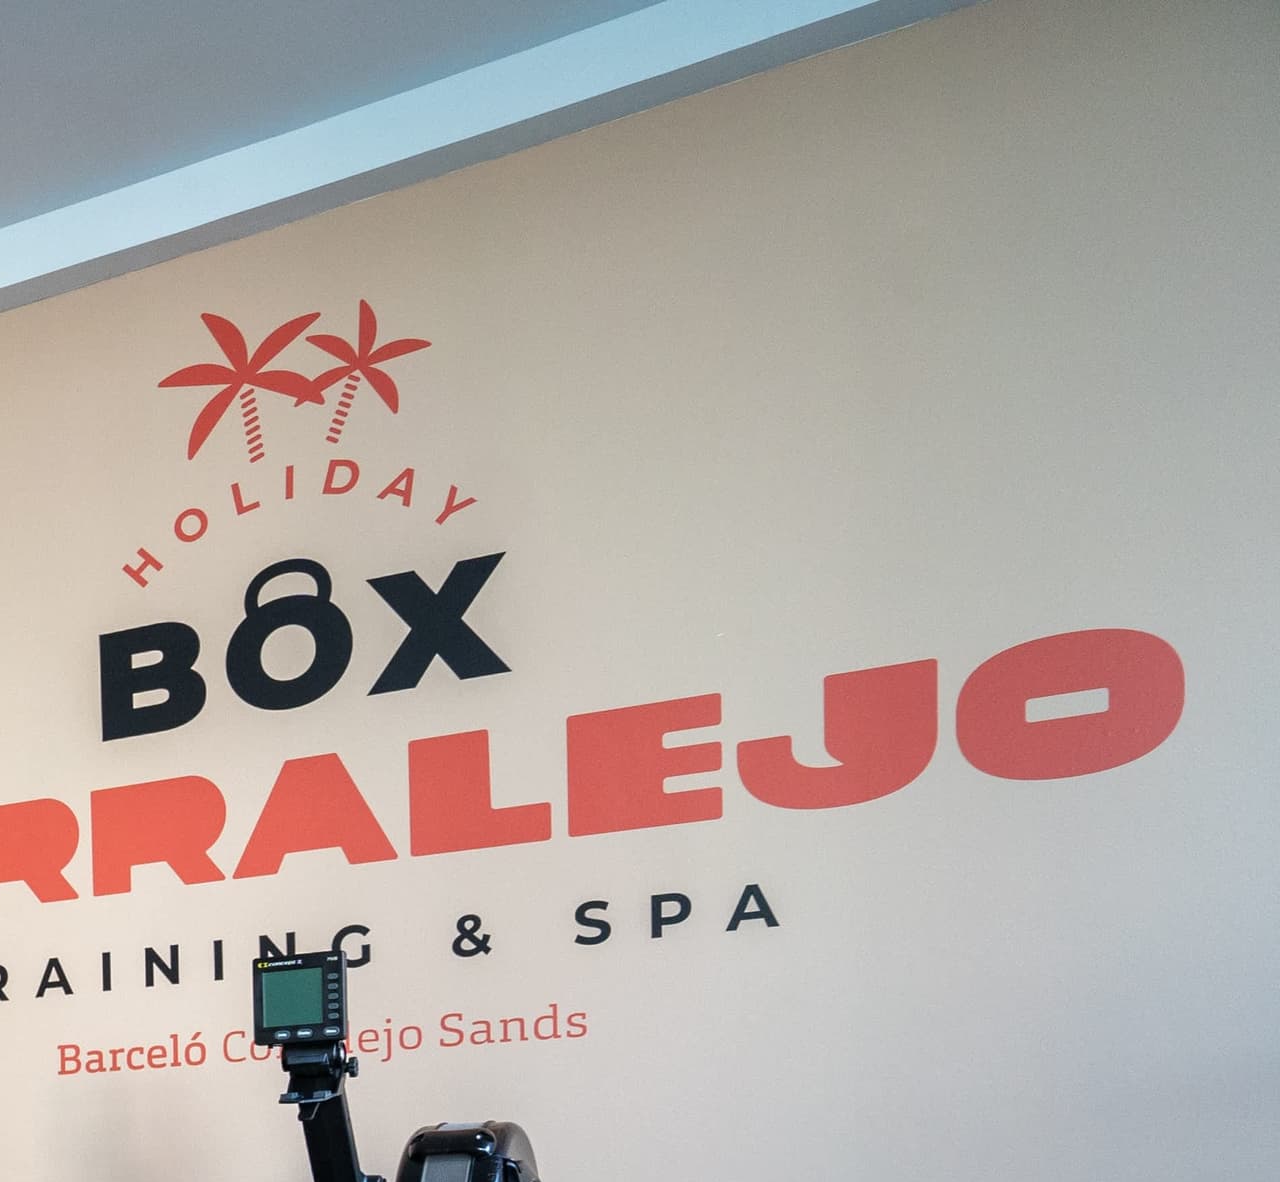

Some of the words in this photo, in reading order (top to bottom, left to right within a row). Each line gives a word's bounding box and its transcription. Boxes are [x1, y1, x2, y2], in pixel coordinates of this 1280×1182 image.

[122, 459, 478, 588] HOLIDAY
[99, 551, 512, 742] BOX
[452, 914, 492, 958] &
[574, 883, 780, 946] SPA
[57, 1032, 207, 1076] Barceló
[439, 1003, 587, 1048] Sands
